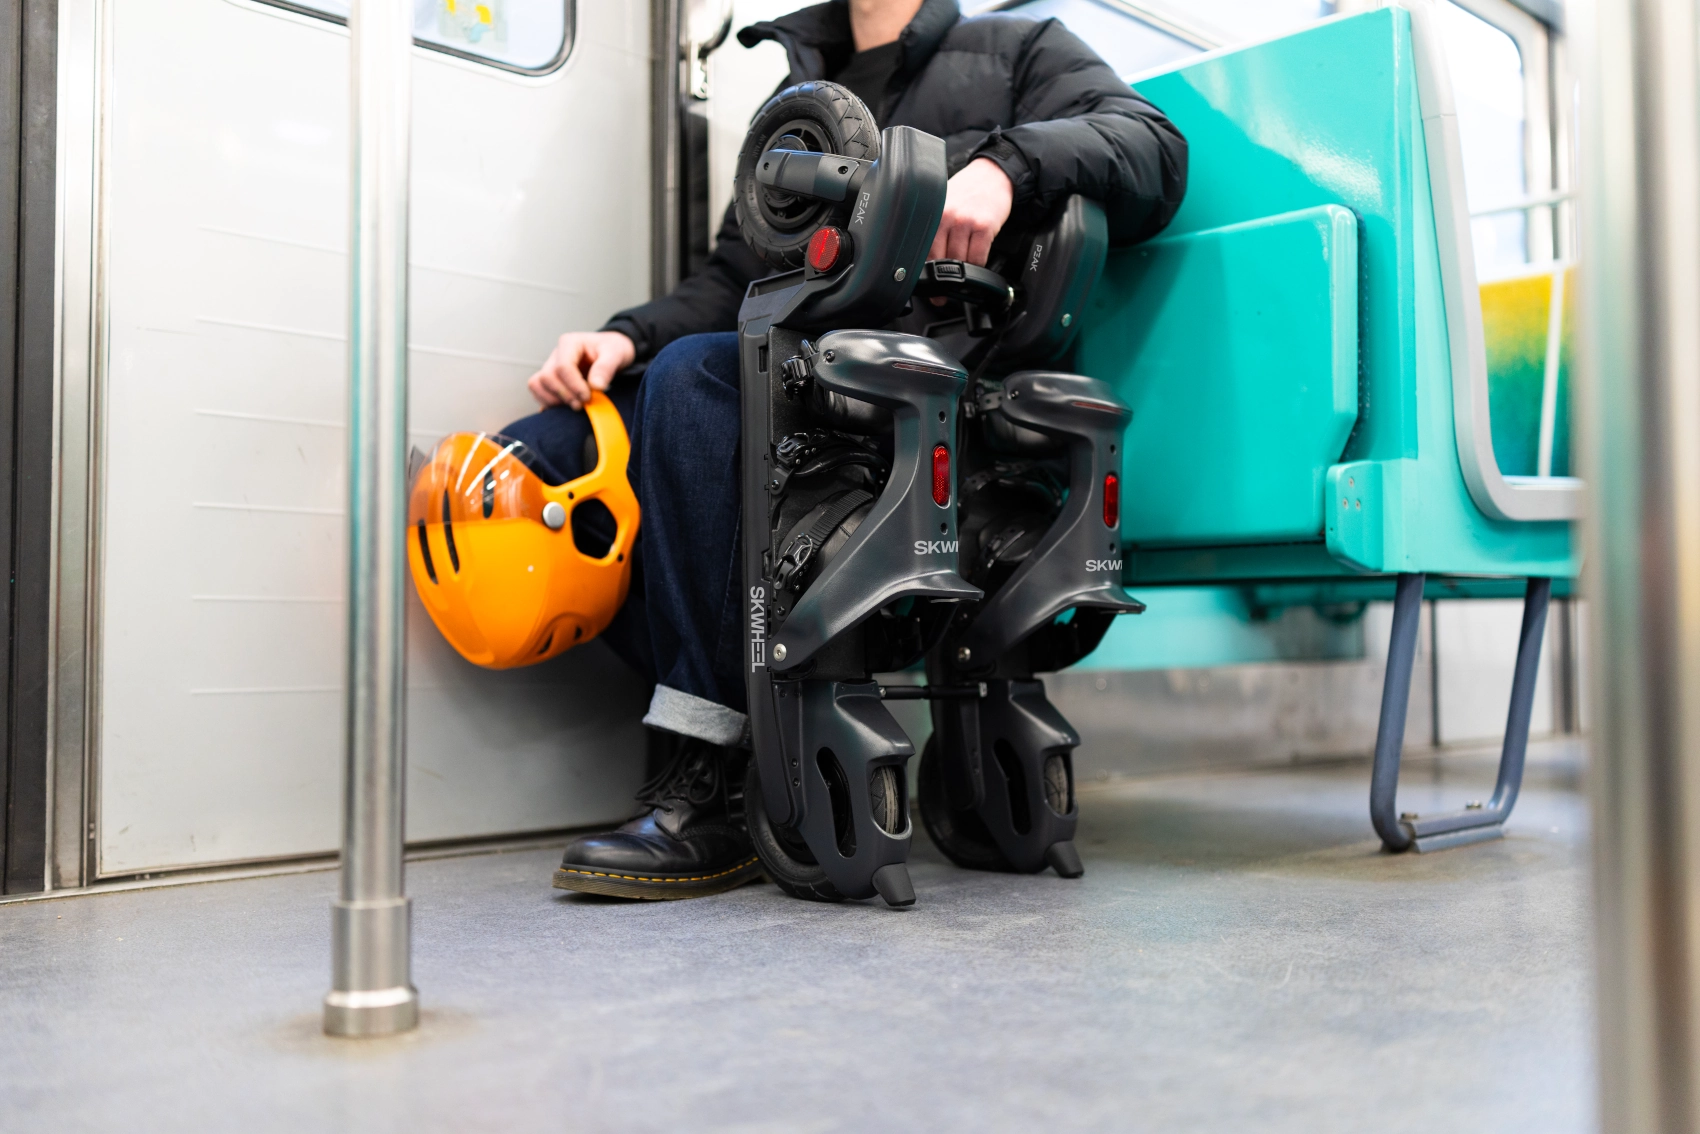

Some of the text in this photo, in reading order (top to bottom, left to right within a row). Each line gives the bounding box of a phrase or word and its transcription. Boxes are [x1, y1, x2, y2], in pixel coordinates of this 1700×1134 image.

[854, 191, 871, 225] PEAK
[1029, 244, 1043, 272] PEAK
[1085, 559, 1123, 572] SKW
